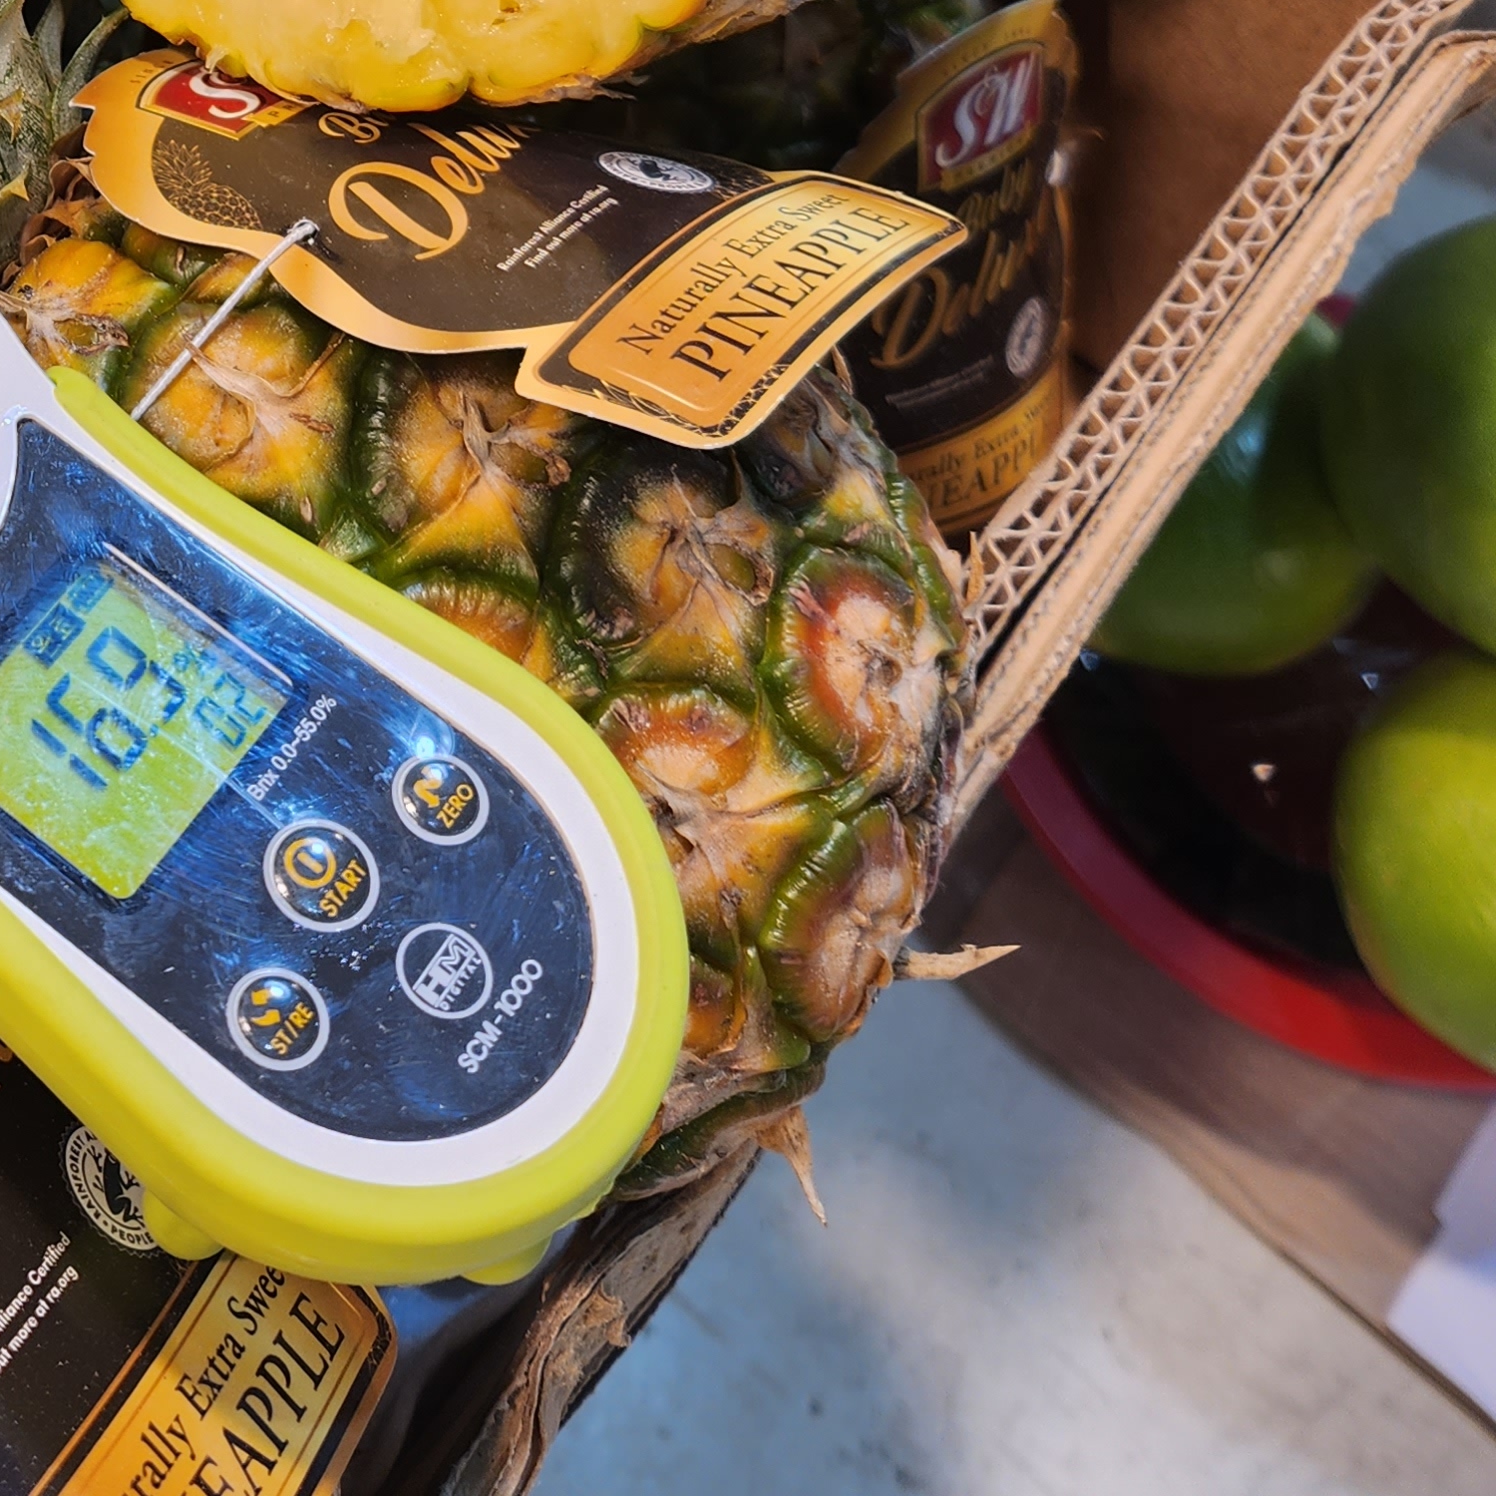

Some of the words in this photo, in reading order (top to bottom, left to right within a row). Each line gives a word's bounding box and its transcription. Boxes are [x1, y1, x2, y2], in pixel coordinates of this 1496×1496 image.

[328, 120, 541, 261] Delu
[496, 231, 544, 272] Rainforest
[539, 208, 574, 235] Alliance
[570, 184, 609, 210] Certified
[524, 246, 549, 269] Find
[546, 236, 563, 252] out
[559, 220, 583, 241] more
[616, 255, 747, 356] Naturally
[723, 217, 798, 261] Extra
[778, 193, 849, 223] Sweet
[670, 207, 911, 383] PINEAPPLE
[31, 625, 187, 792] 16.9
[247, 769, 280, 801] Brix
[436, 783, 475, 829] ZERO
[319, 860, 366, 918] START
[412, 933, 476, 1008] HM
[439, 957, 482, 1011] DIGITAL
[270, 1001, 315, 1055] ST/RE
[457, 959, 543, 1074] SCM-1000
[69, 1135, 101, 1219] RAINFOREST
[28, 1231, 71, 1286] Certified
[7, 1315, 39, 1353] more
[34, 1299, 50, 1318] at
[45, 1265, 80, 1304] ra.org
[175, 1332, 246, 1421] Extra
[227, 1265, 286, 1336] Swee
